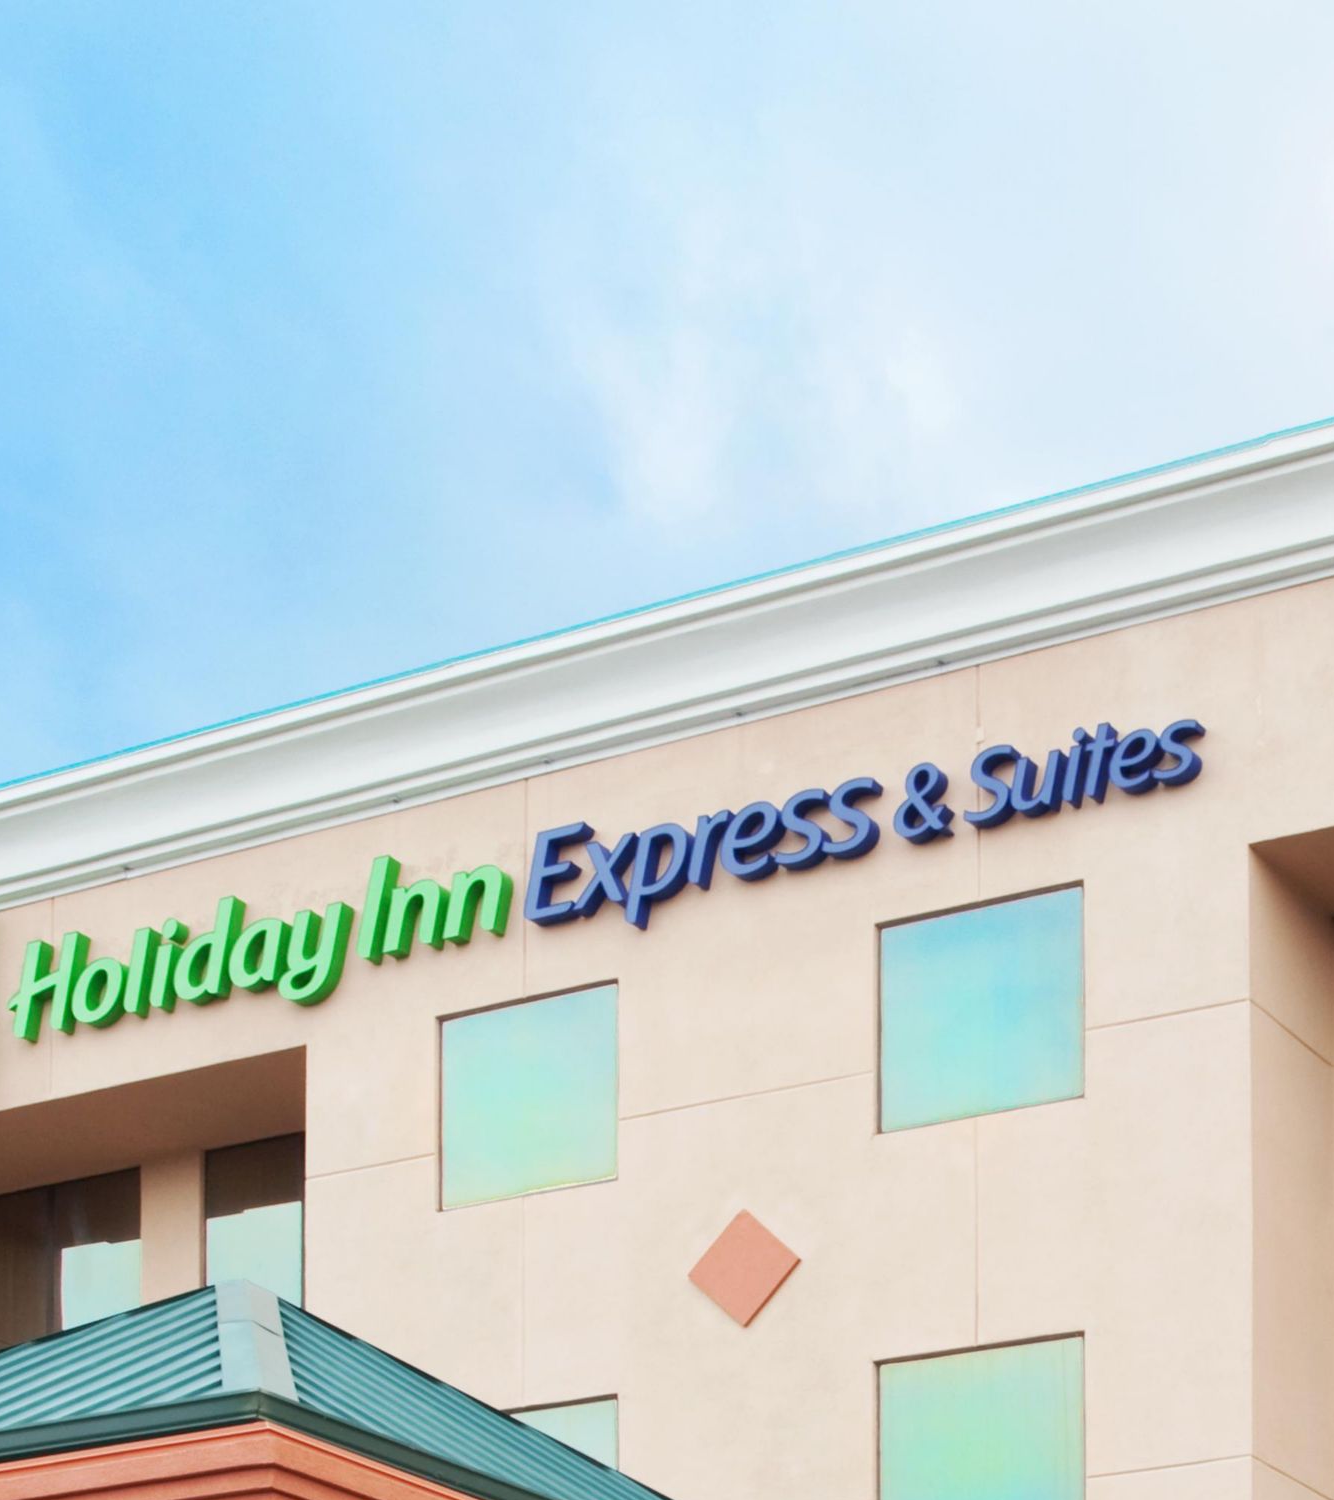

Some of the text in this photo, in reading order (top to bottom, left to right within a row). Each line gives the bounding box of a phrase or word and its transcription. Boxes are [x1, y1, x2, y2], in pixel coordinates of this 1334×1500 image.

[7, 718, 1207, 1043] Holiday Inn Express & Suites
